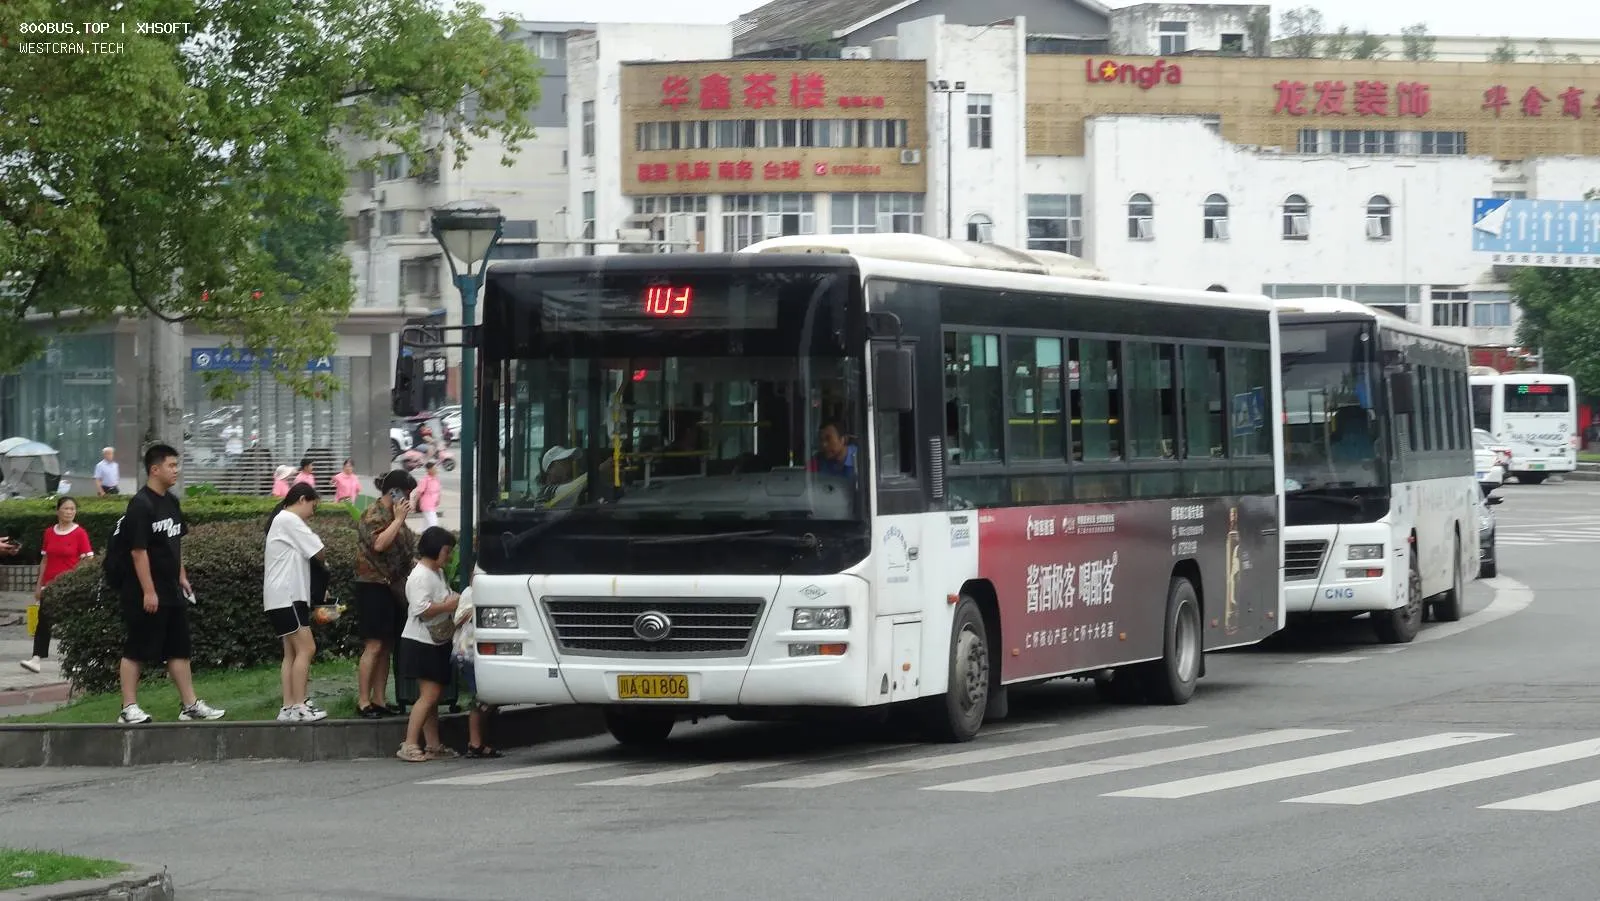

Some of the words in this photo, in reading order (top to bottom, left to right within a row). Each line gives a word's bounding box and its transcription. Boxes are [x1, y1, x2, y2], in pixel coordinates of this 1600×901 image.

[661, 72, 826, 112] 华鑫茶楼
[1085, 58, 1183, 90] Longfa
[1273, 80, 1432, 117] 龙发装饰
[1026, 562, 1076, 614] 酱酒极客
[1325, 588, 1354, 599] CNG
